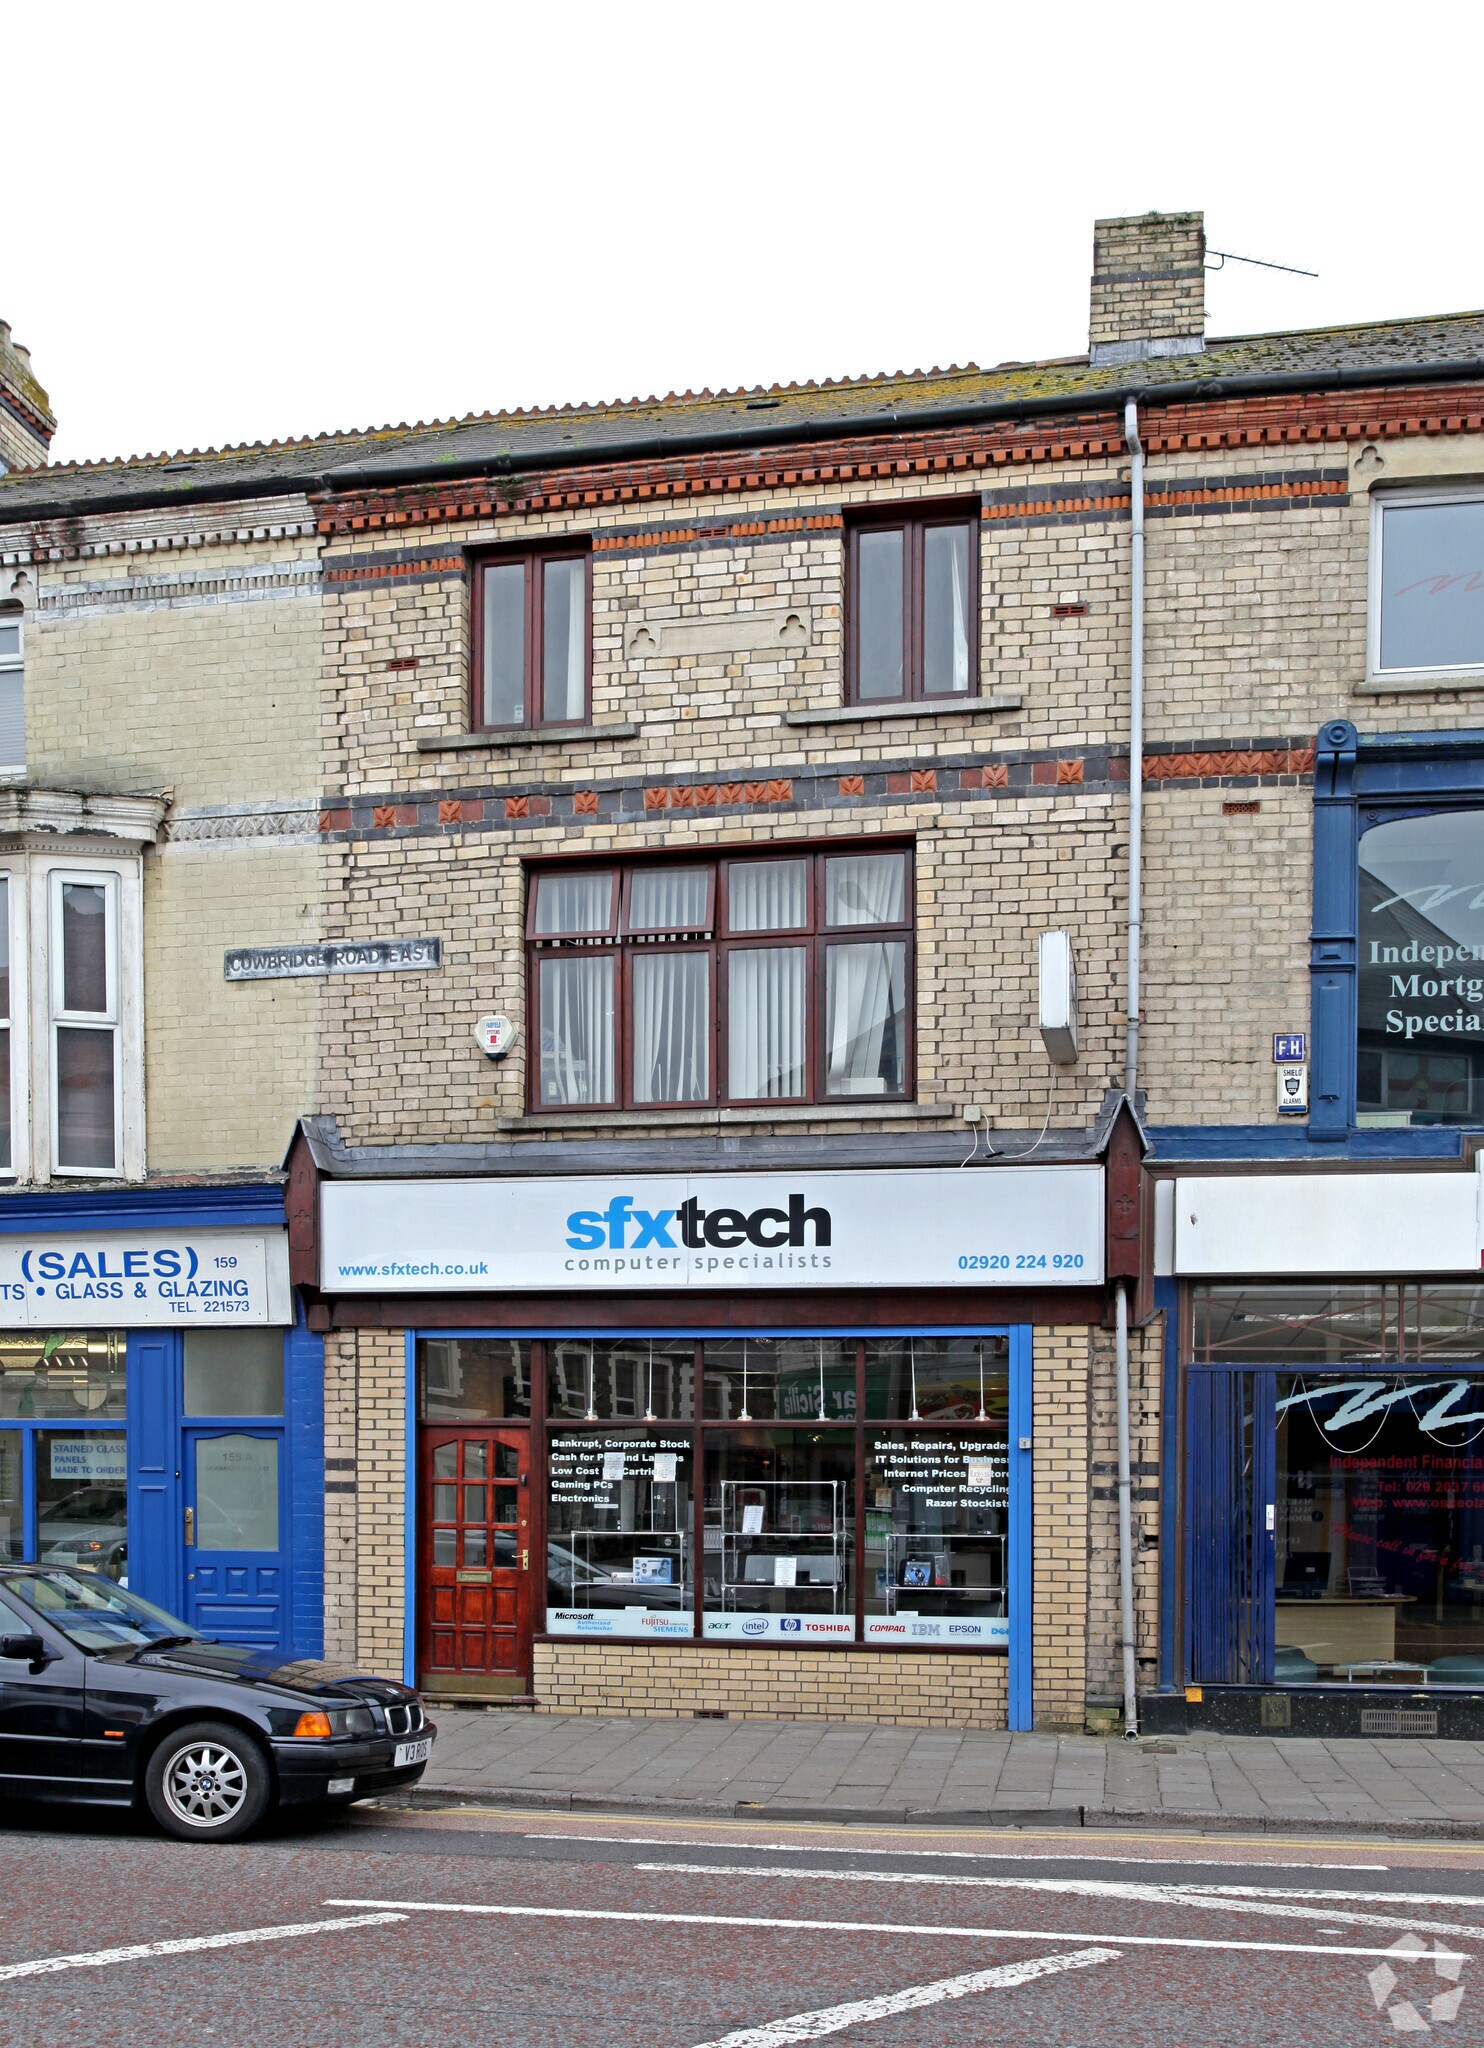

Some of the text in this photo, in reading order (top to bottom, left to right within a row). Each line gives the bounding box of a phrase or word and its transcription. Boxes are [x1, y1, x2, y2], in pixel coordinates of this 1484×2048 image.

[231, 944, 435, 972] COWBRIDGE ROAD EAST
[1389, 974, 1484, 1002] Mortg
[1386, 1008, 1484, 1040] Specia
[1278, 1040, 1302, 1056] F.H.
[1282, 1069, 1303, 1077] SHIELD
[565, 1193, 832, 1250] sfxtech
[21, 1247, 238, 1282] (SALES) 159
[564, 1253, 832, 1274] computer specialists
[958, 1254, 1085, 1270] 02920 224 920
[338, 1261, 489, 1277] www.sfxtech.co.uk
[55, 1282, 124, 1299] GLASS
[133, 1281, 148, 1298] &
[158, 1279, 249, 1298] GLAZING
[169, 1300, 250, 1313] TEL. 221573
[53, 1445, 126, 1454] STAINED GLASS
[551, 1439, 691, 1450] Bankrupt, Corporate Stock
[874, 1441, 908, 1452] Sales,
[910, 1441, 957, 1452] Repairs,
[54, 1456, 87, 1464] PANELS
[551, 1453, 577, 1461] Cash
[580, 1453, 594, 1461] for
[623, 1453, 639, 1462] nd
[875, 1455, 887, 1464] IT
[889, 1455, 941, 1464] Solutions
[943, 1455, 960, 1464] for
[1329, 1454, 1484, 1471] Independent Financia
[54, 1466, 126, 1474] MADE TO ORDER
[551, 1467, 573, 1476] Low
[575, 1467, 600, 1476] Cost
[884, 1469, 929, 1478] Internet
[931, 1469, 966, 1478] Prices
[551, 1481, 614, 1490] Gaming PCs
[902, 1484, 956, 1495] Computer
[1377, 1481, 1401, 1493] Tel:
[551, 1494, 610, 1503] Electronics
[926, 1498, 957, 1508] Razer
[1351, 1496, 1388, 1508] Web:
[554, 1612, 594, 1621] Microsoft
[641, 1617, 669, 1627] FUJITSU
[708, 1622, 731, 1630] acer
[745, 1621, 765, 1631] intel
[653, 1625, 689, 1633] SIEMENS
[805, 1623, 851, 1632] TOSHIBA
[869, 1624, 906, 1633] COMPAQ
[911, 1624, 941, 1636] IBM
[949, 1625, 982, 1634] EPSON
